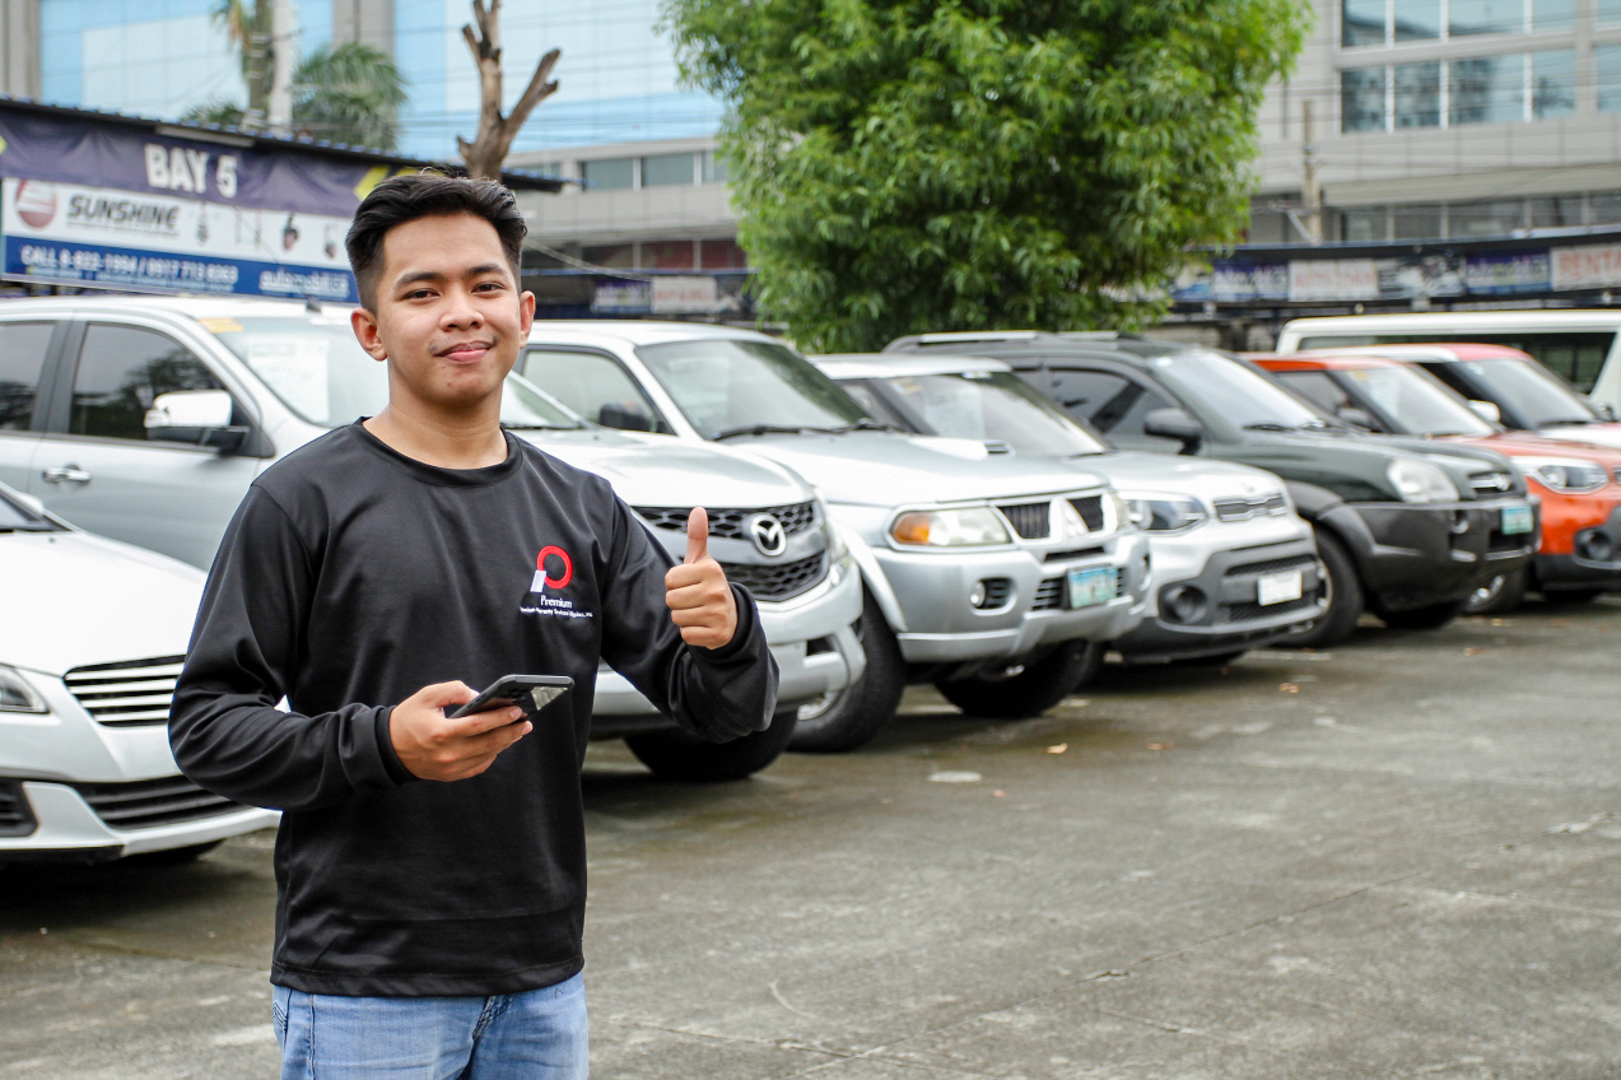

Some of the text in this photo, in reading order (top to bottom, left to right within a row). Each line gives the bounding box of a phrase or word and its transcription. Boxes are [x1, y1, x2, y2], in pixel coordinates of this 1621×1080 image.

[144, 143, 238, 199] BAY 5
[67, 194, 181, 228] SUNSHINE
[21, 244, 58, 268] CALL
[540, 594, 572, 608] Premium
